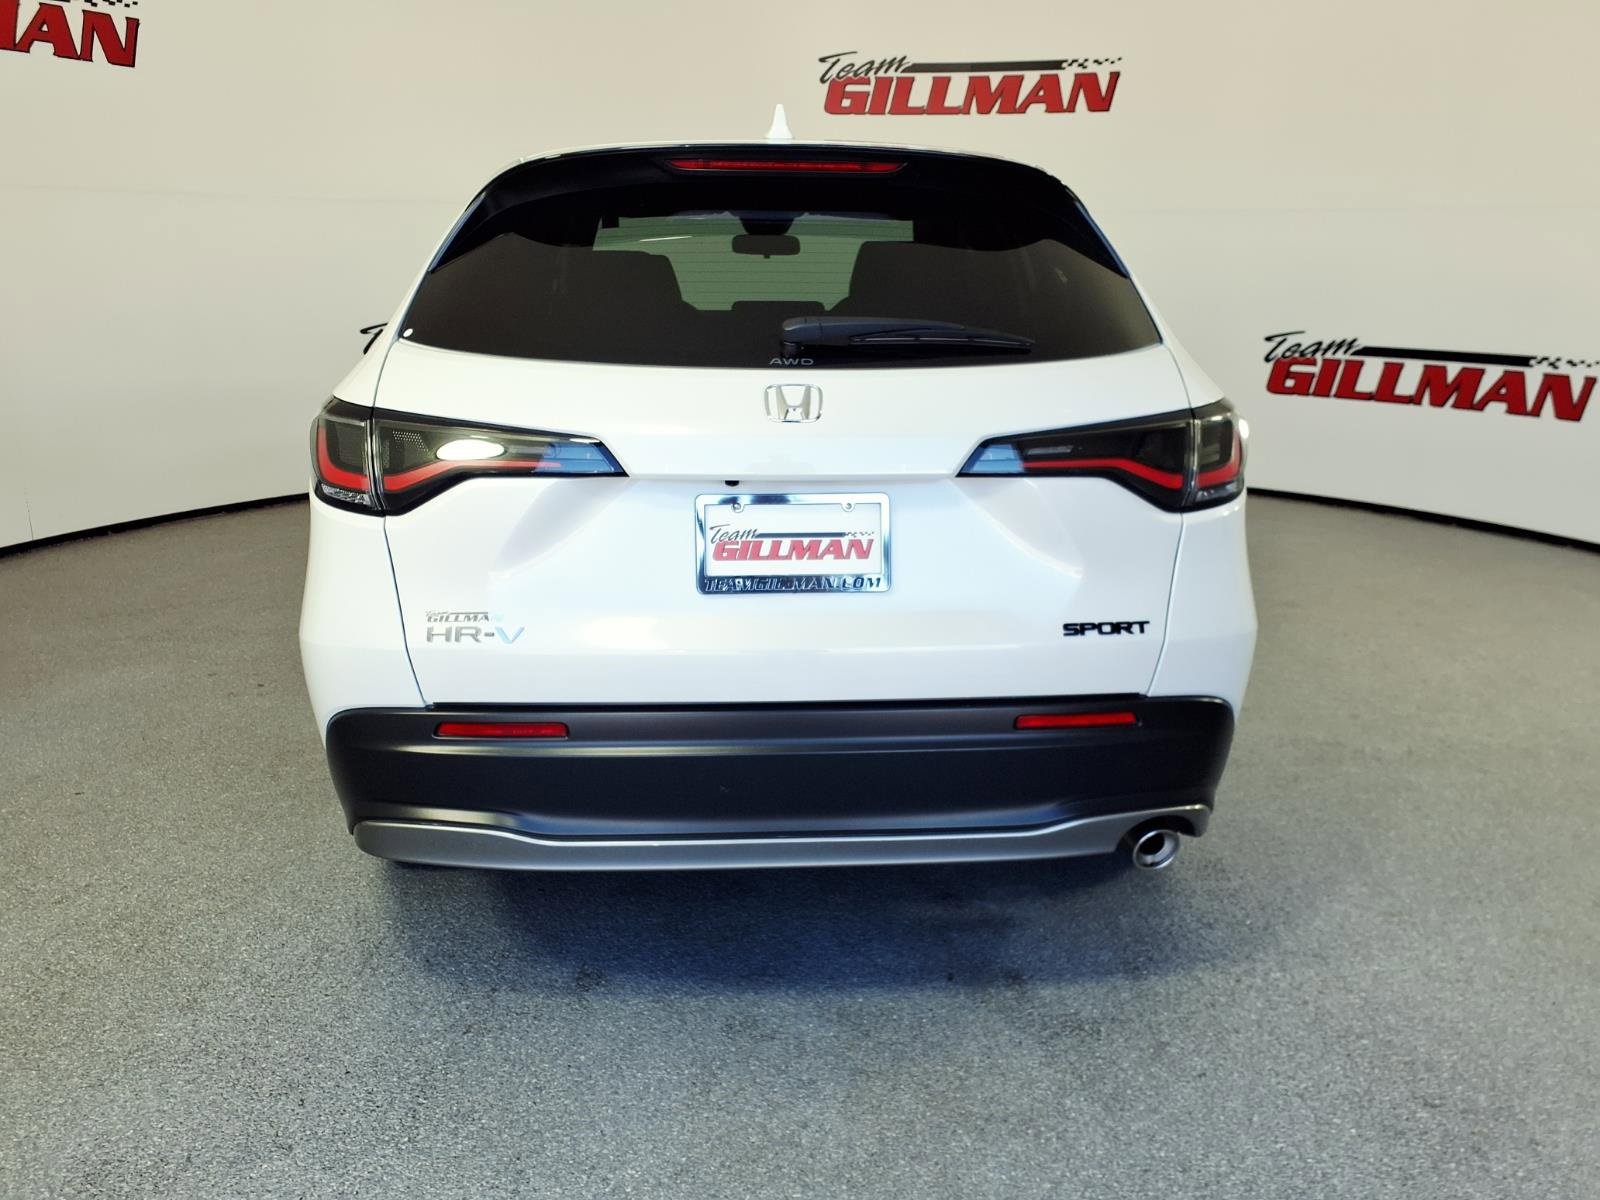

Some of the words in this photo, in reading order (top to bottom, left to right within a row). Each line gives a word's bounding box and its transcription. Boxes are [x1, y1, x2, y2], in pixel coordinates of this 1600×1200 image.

[0, 0, 140, 68] AN
[818, 51, 909, 84] Team
[824, 71, 1121, 115] GILLMAN
[1264, 330, 1360, 363] Team
[769, 358, 814, 366] AWD
[1266, 356, 1598, 422] GILLMAN
[709, 523, 757, 544] Team
[712, 538, 875, 561] GILLMAN
[426, 626, 526, 644] HR-V
[1062, 620, 1151, 637] SPORT
